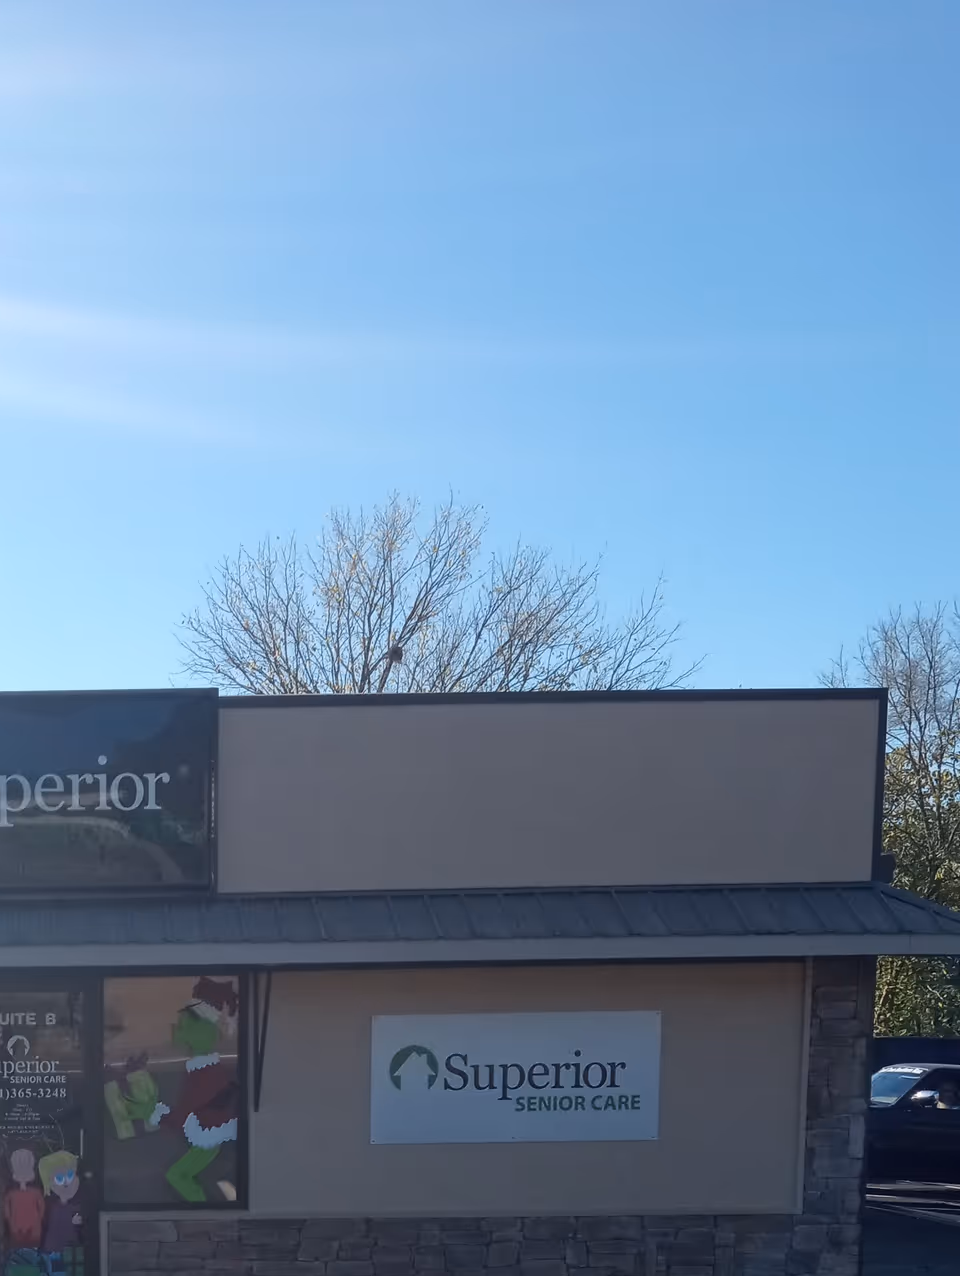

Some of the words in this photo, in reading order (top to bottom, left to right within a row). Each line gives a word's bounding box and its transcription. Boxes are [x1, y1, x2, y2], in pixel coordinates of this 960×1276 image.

[45, 1013, 57, 1025] B
[10, 1076, 42, 1084] SENIOR
[44, 1075, 66, 1083] CARE
[443, 1049, 626, 1100] Superior
[514, 1095, 586, 1112] SENIOR
[590, 1095, 641, 1111] CARE
